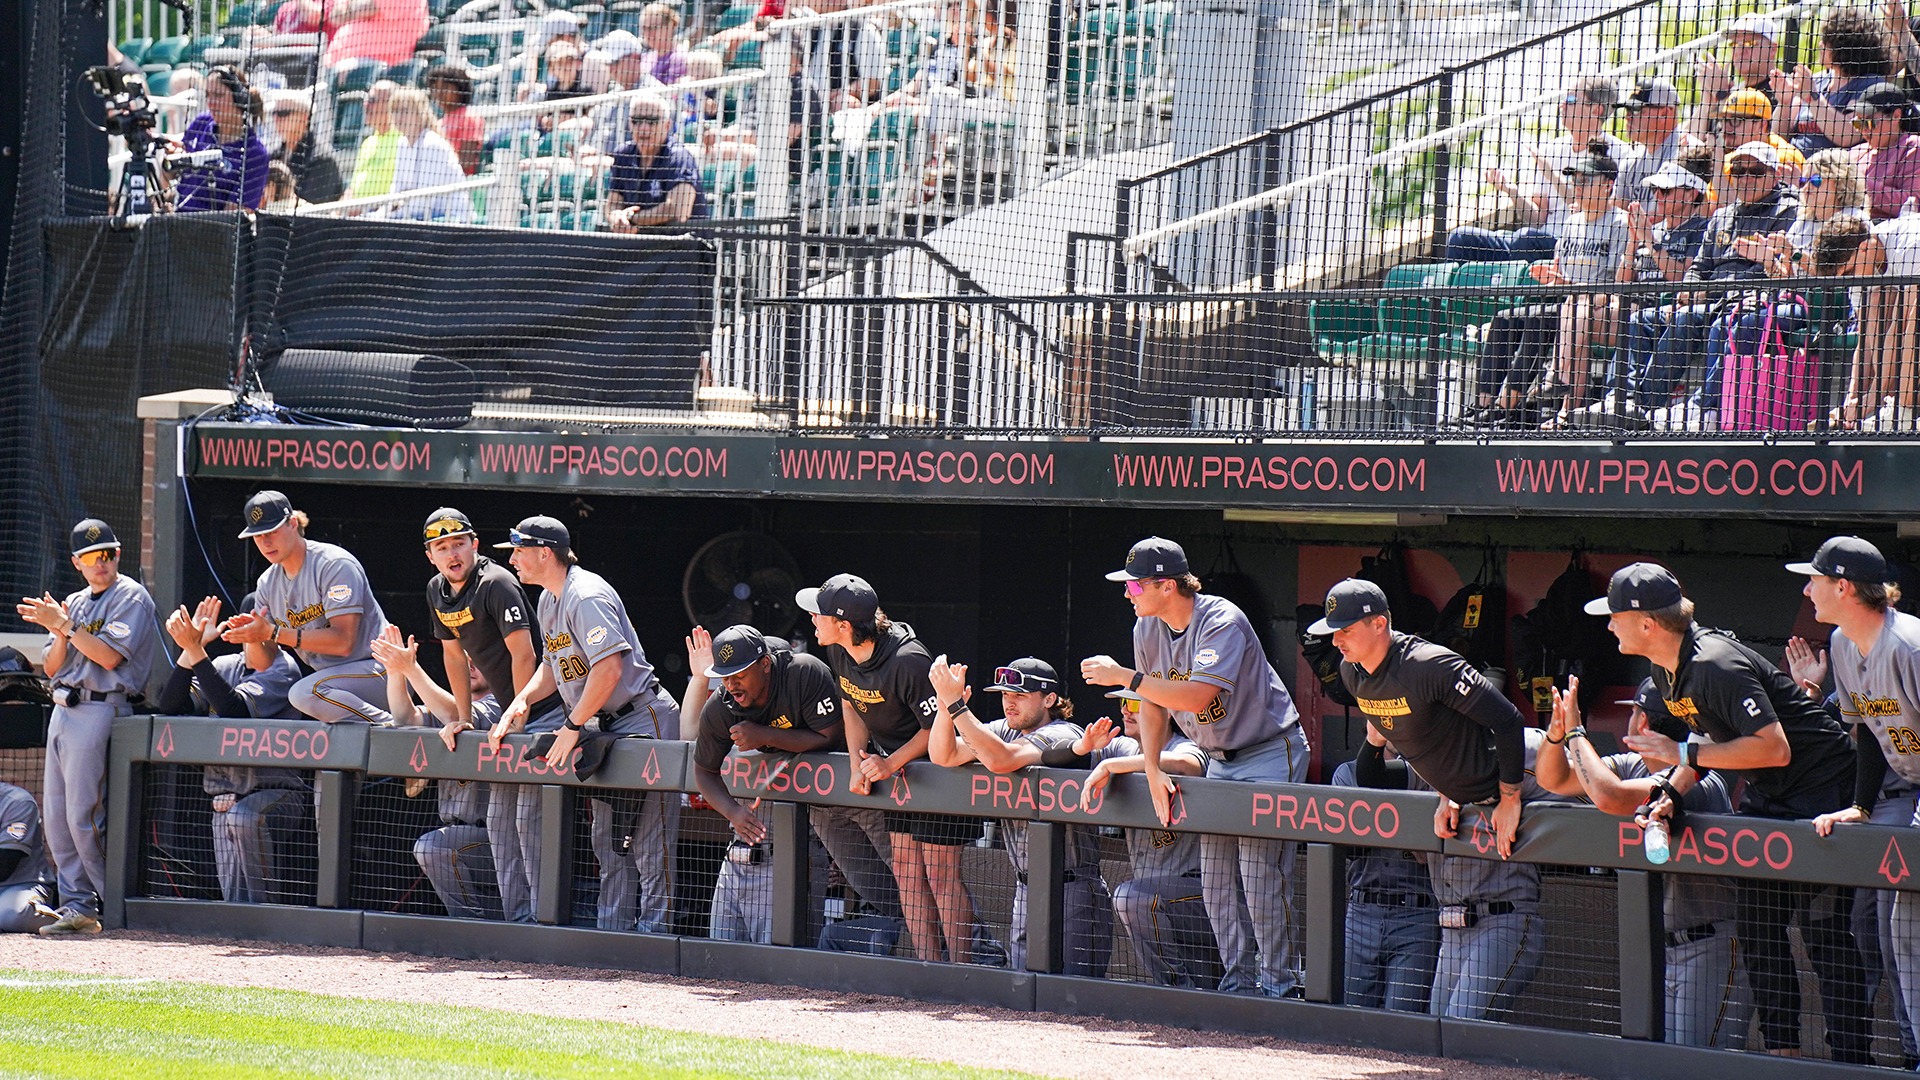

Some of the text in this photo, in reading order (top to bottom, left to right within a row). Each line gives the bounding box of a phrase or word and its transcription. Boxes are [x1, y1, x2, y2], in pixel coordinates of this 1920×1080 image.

[201, 437, 431, 471] WWW.PRASCO.COM
[479, 442, 728, 478] WWW.PRASCO.COM
[780, 449, 1055, 485] WWW.PRASCO.COM
[1113, 454, 1426, 492] WWW.PRASCO.COM
[1495, 458, 1864, 496] WWW.PRASCO.COM
[504, 606, 522, 623] 43
[559, 654, 589, 683] 20
[1454, 668, 1478, 697] 27
[816, 696, 835, 716] 45
[919, 695, 938, 717] 38
[1742, 697, 1762, 718] 2
[221, 727, 329, 760] PRASCO
[1886, 725, 1920, 756] 23
[1251, 792, 1401, 839] PRASCO
[1618, 820, 1793, 870] PASCO
